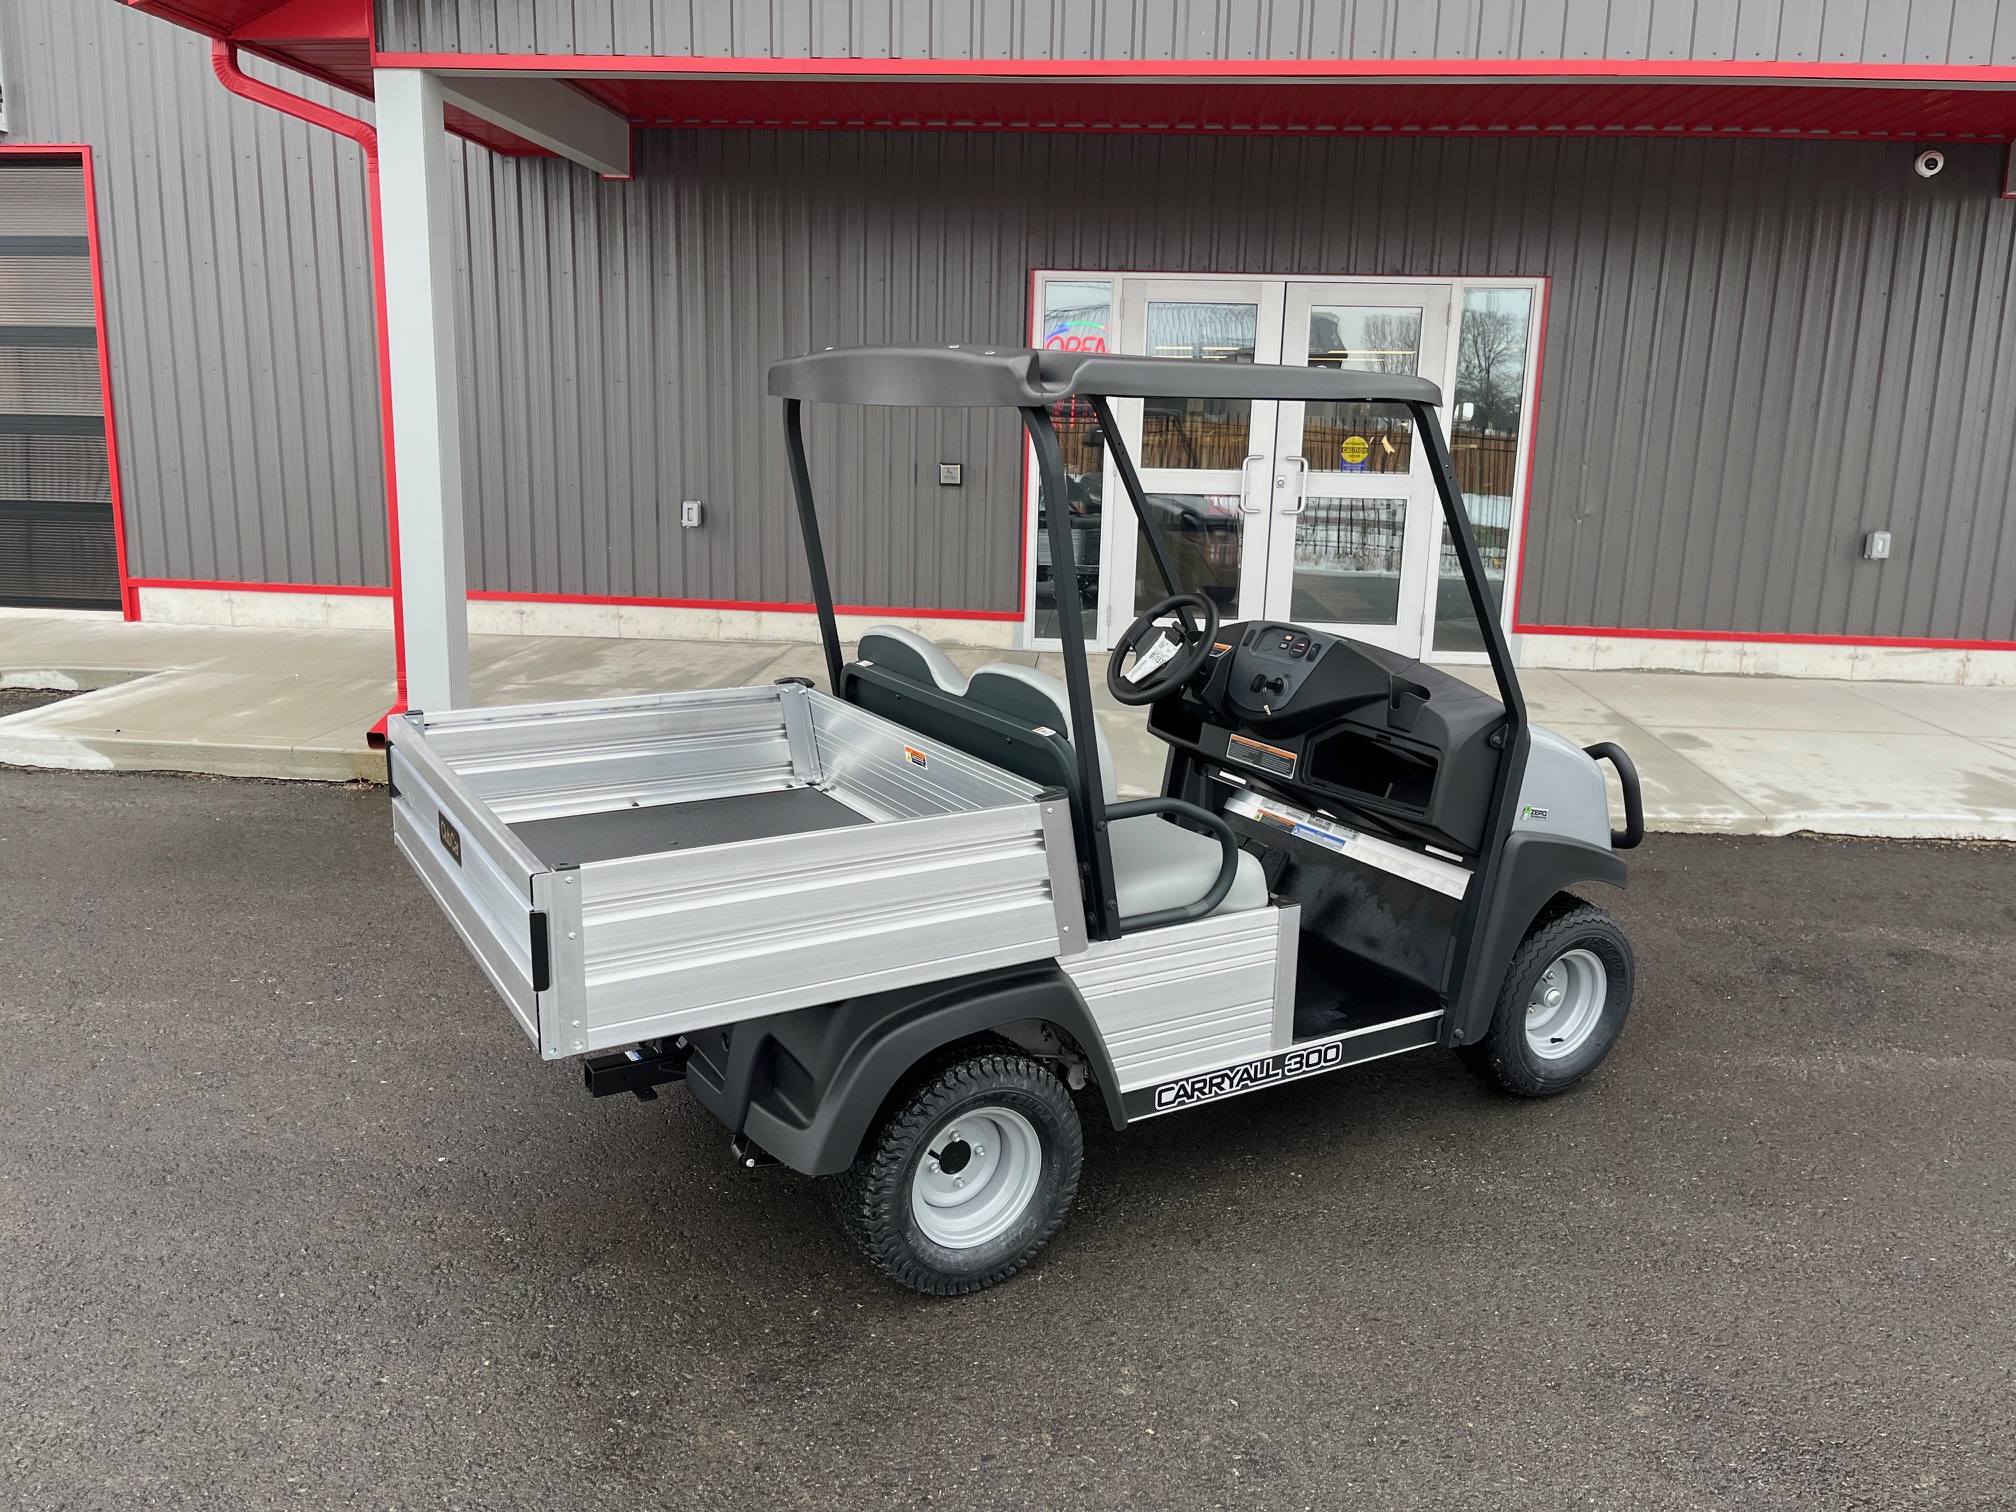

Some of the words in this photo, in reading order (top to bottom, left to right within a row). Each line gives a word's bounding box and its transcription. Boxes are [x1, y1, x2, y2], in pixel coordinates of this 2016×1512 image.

[1155, 1058, 1282, 1110] CARRYALL
[1285, 1042, 1343, 1076] 300
[1002, 1093, 1052, 1124] KENDA
